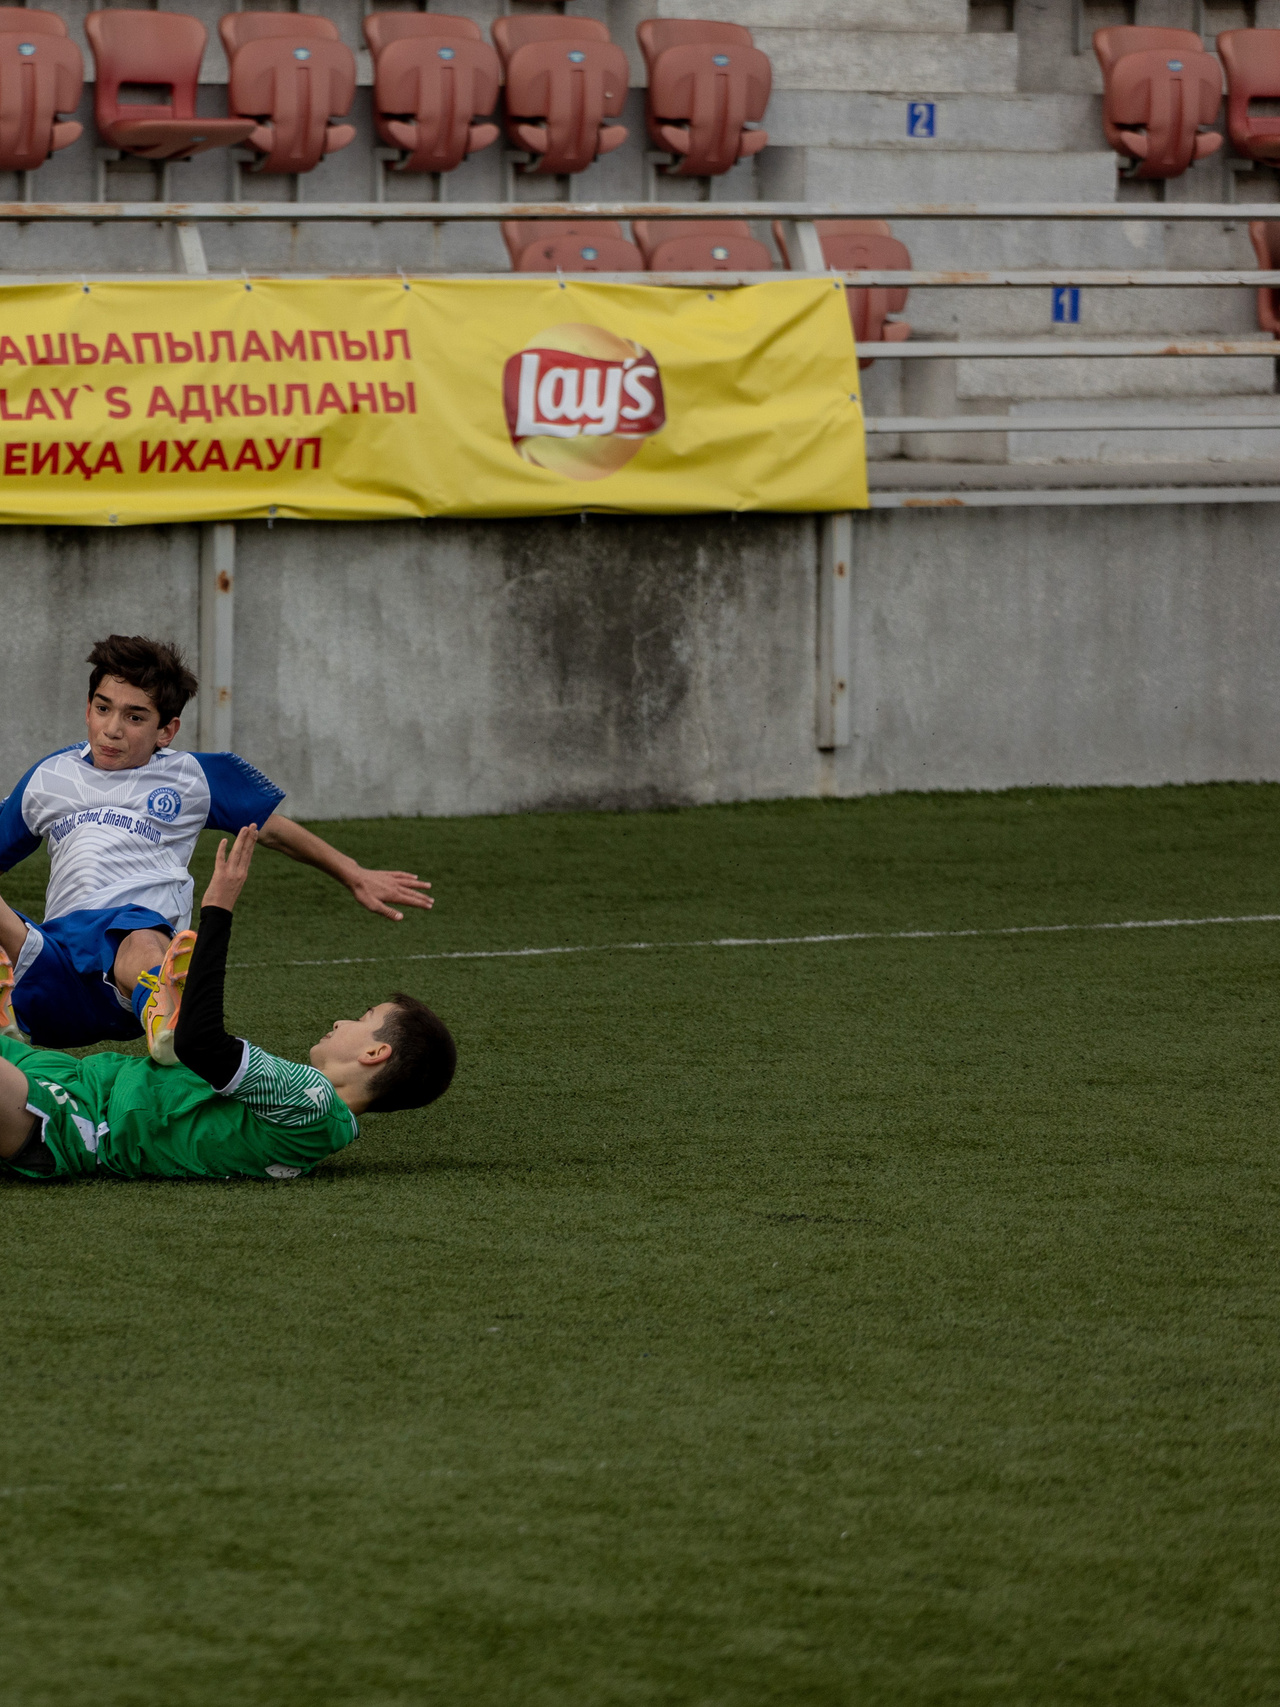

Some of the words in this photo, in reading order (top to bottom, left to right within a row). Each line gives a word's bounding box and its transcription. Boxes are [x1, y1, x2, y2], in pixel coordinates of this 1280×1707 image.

[913, 104, 931, 136] 2
[1058, 288, 1070, 323] 1
[146, 381, 417, 425] АДКЫЛАНЫ
[515, 353, 657, 439] Lay's
[138, 436, 322, 474] ИХААУП
